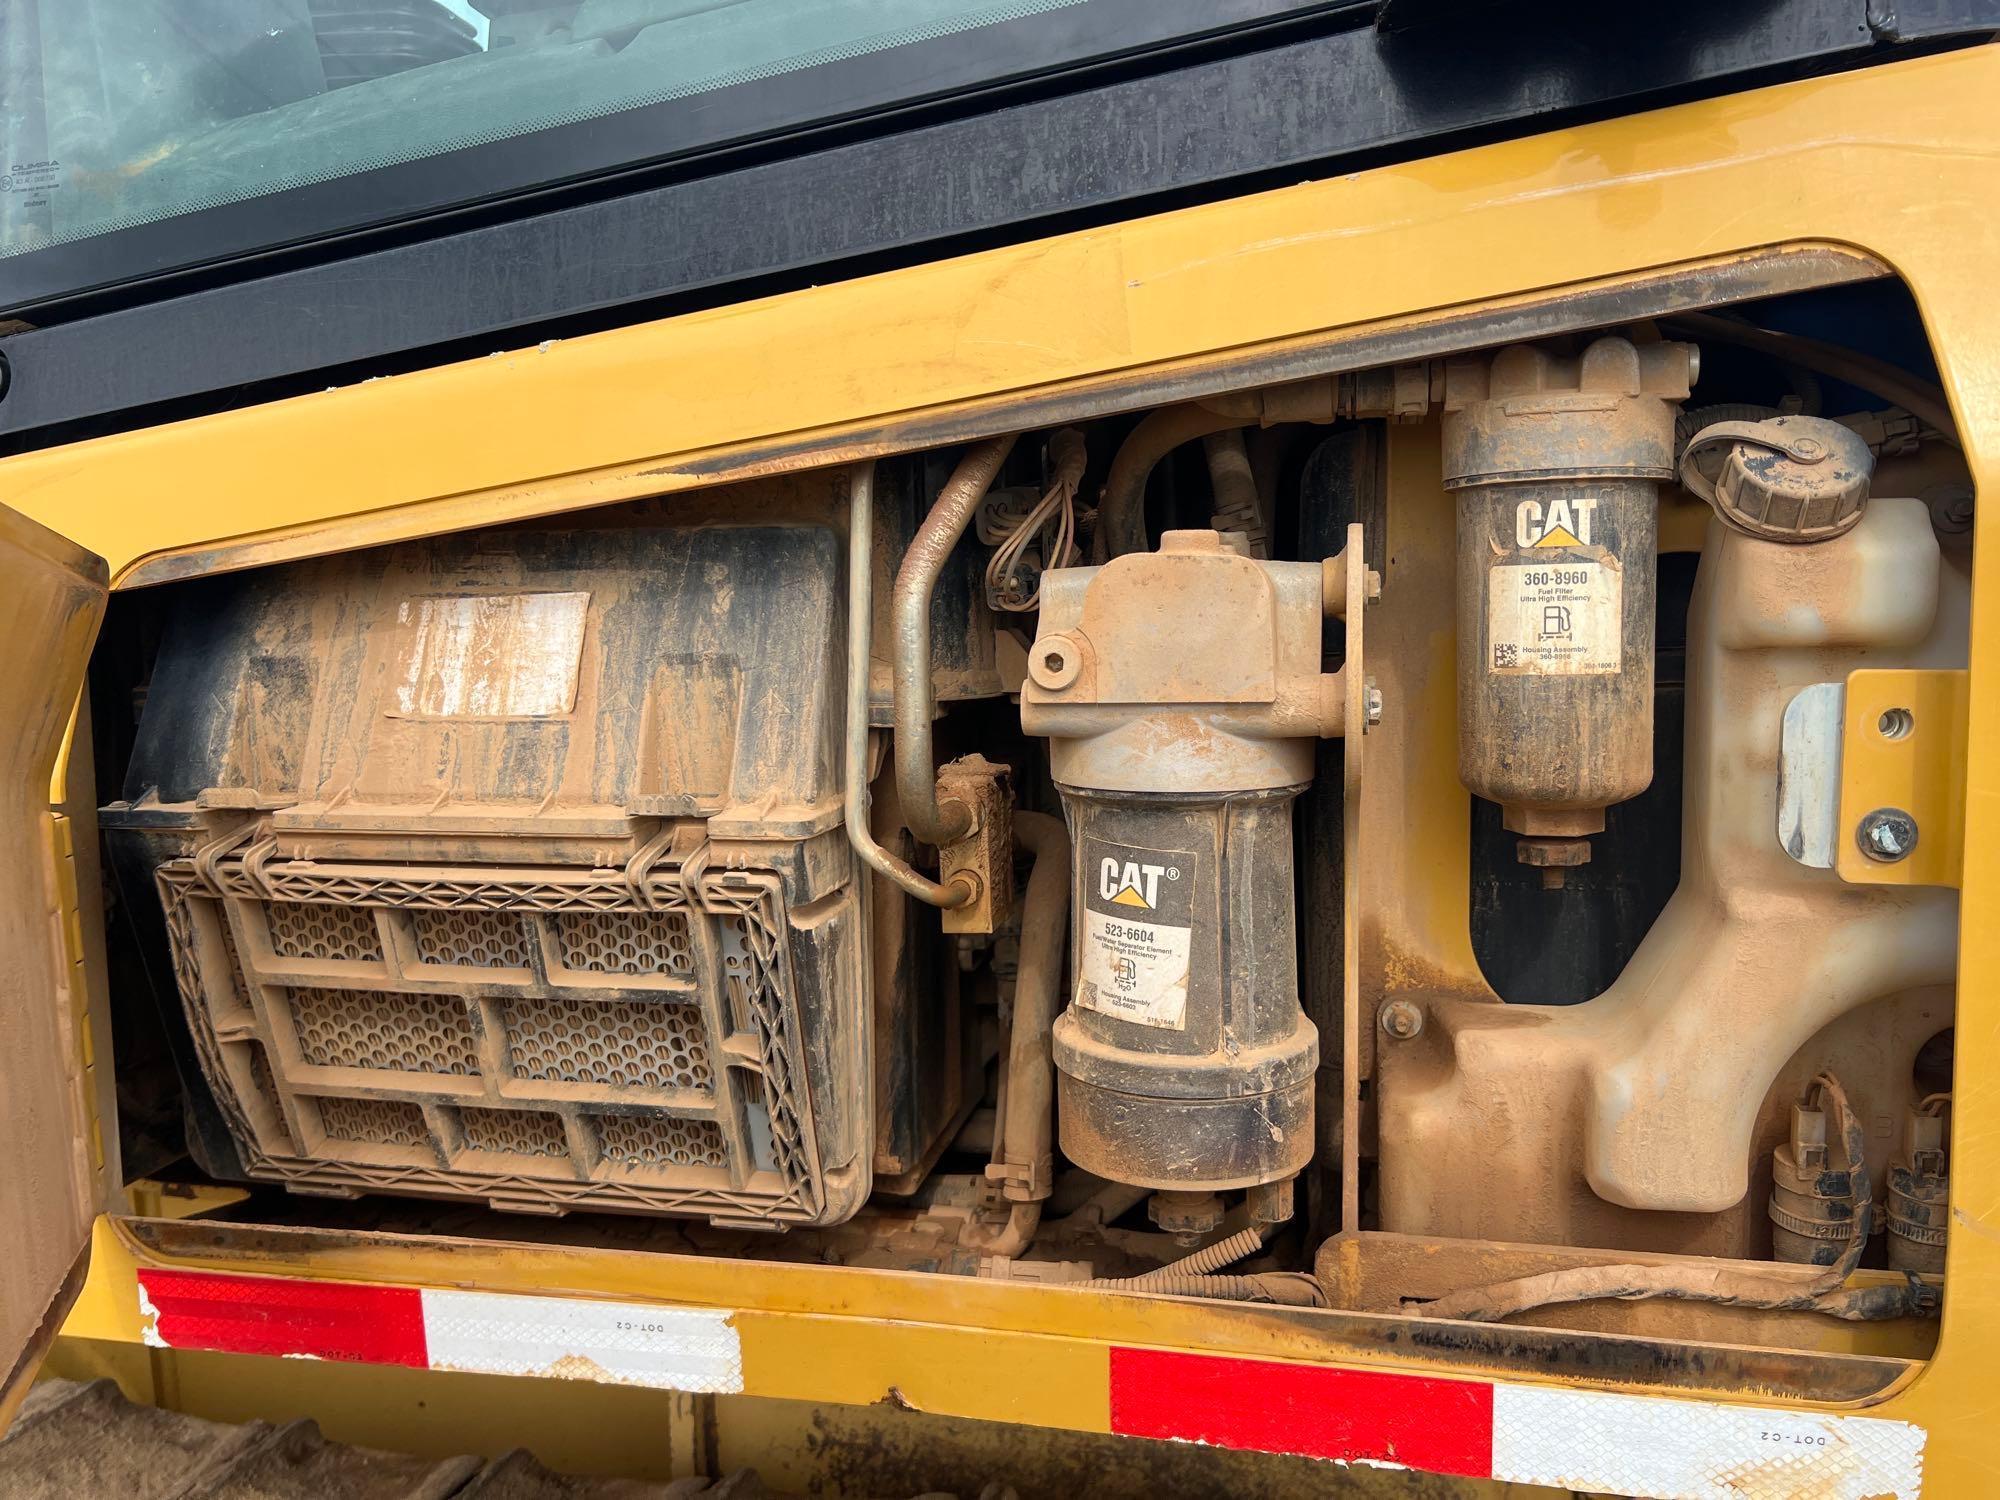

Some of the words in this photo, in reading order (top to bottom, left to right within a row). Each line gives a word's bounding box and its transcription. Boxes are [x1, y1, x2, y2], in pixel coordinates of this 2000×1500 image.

[1516, 499, 1598, 548] CAT
[1524, 571, 1588, 586] 360-8960
[1538, 595, 1555, 603] High
[1557, 594, 1591, 602] Efficiency
[1522, 646, 1552, 654] Housing
[1105, 922, 1155, 943] 523-6604
[1101, 942, 1114, 951] Ultra
[1114, 946, 1127, 955] High
[1127, 949, 1157, 960] Efficiency
[1117, 939, 1146, 951] Separator
[1146, 945, 1172, 955] Element
[1101, 989, 1122, 1001] Housing
[1122, 995, 1151, 1008] Assembly
[616, 1321, 664, 1333] DOT-C2
[1761, 1431, 1826, 1446] DOT-C2
